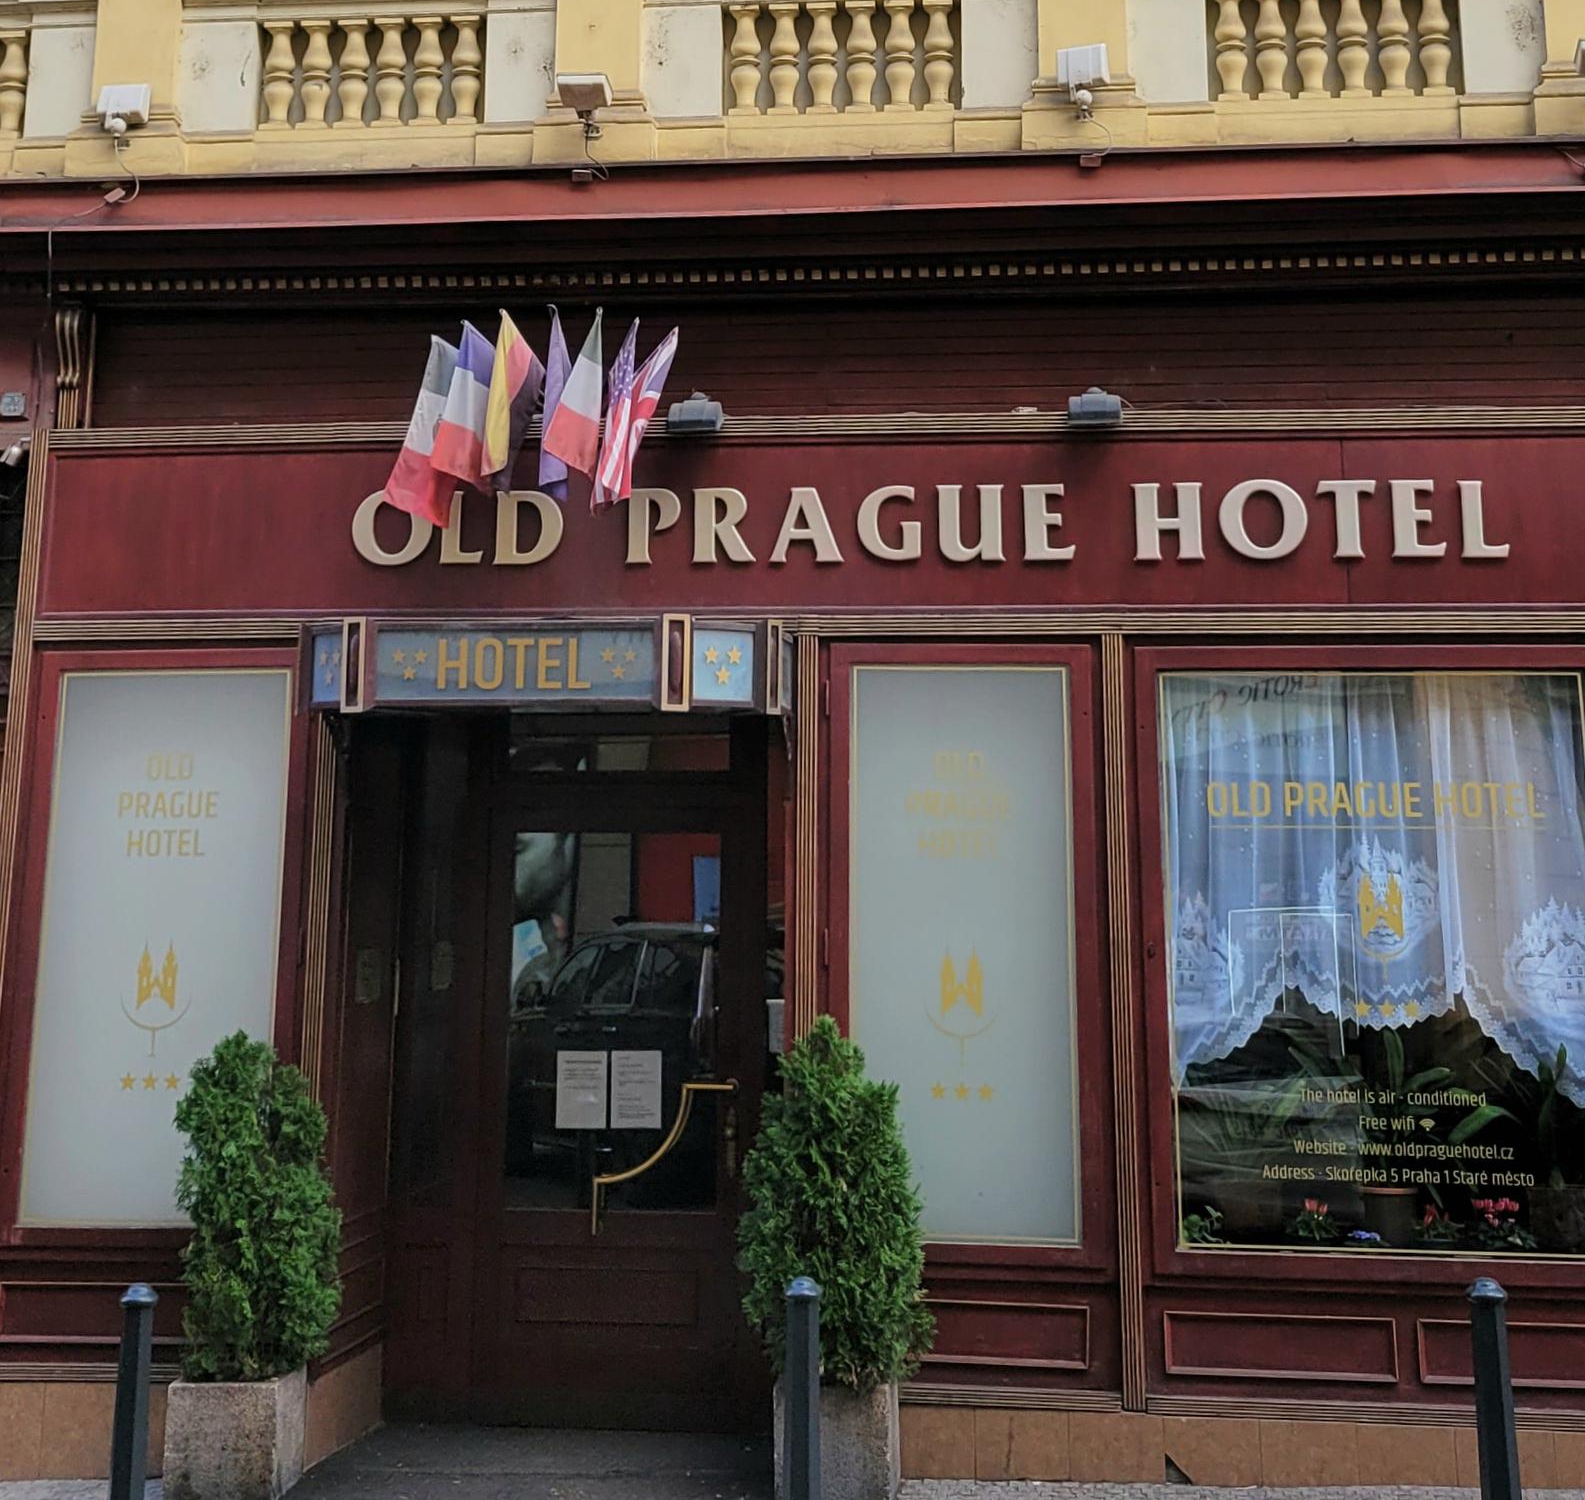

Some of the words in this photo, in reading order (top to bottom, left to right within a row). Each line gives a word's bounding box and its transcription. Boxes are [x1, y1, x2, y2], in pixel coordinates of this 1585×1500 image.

[352, 489, 564, 566] OLD
[625, 483, 1077, 565] PRAGUE
[1132, 478, 1512, 562] HOTEL
[436, 636, 592, 691] HOTEL
[146, 751, 193, 781] OLD
[117, 790, 220, 819] PRAGUE
[1207, 781, 1271, 818] OLD
[1284, 781, 1424, 819] PRAGUE
[1434, 781, 1546, 819] HOTEL
[127, 828, 205, 857] HOTEL
[1300, 1088, 1323, 1104] The
[1326, 1088, 1361, 1105] hotel
[1364, 1088, 1376, 1104] is
[1378, 1088, 1395, 1104] air
[1407, 1089, 1486, 1108] conditioned
[1359, 1116, 1387, 1131] Free
[1391, 1115, 1415, 1131] wifi
[1293, 1139, 1346, 1156] Website
[1358, 1142, 1515, 1161] www.oldpraguehotel.cz
[1262, 1164, 1315, 1180] Address
[1391, 1169, 1399, 1184] 5
[1402, 1169, 1442, 1184] Praha
[1444, 1169, 1450, 1184] 1
[1453, 1168, 1489, 1186] Staré
